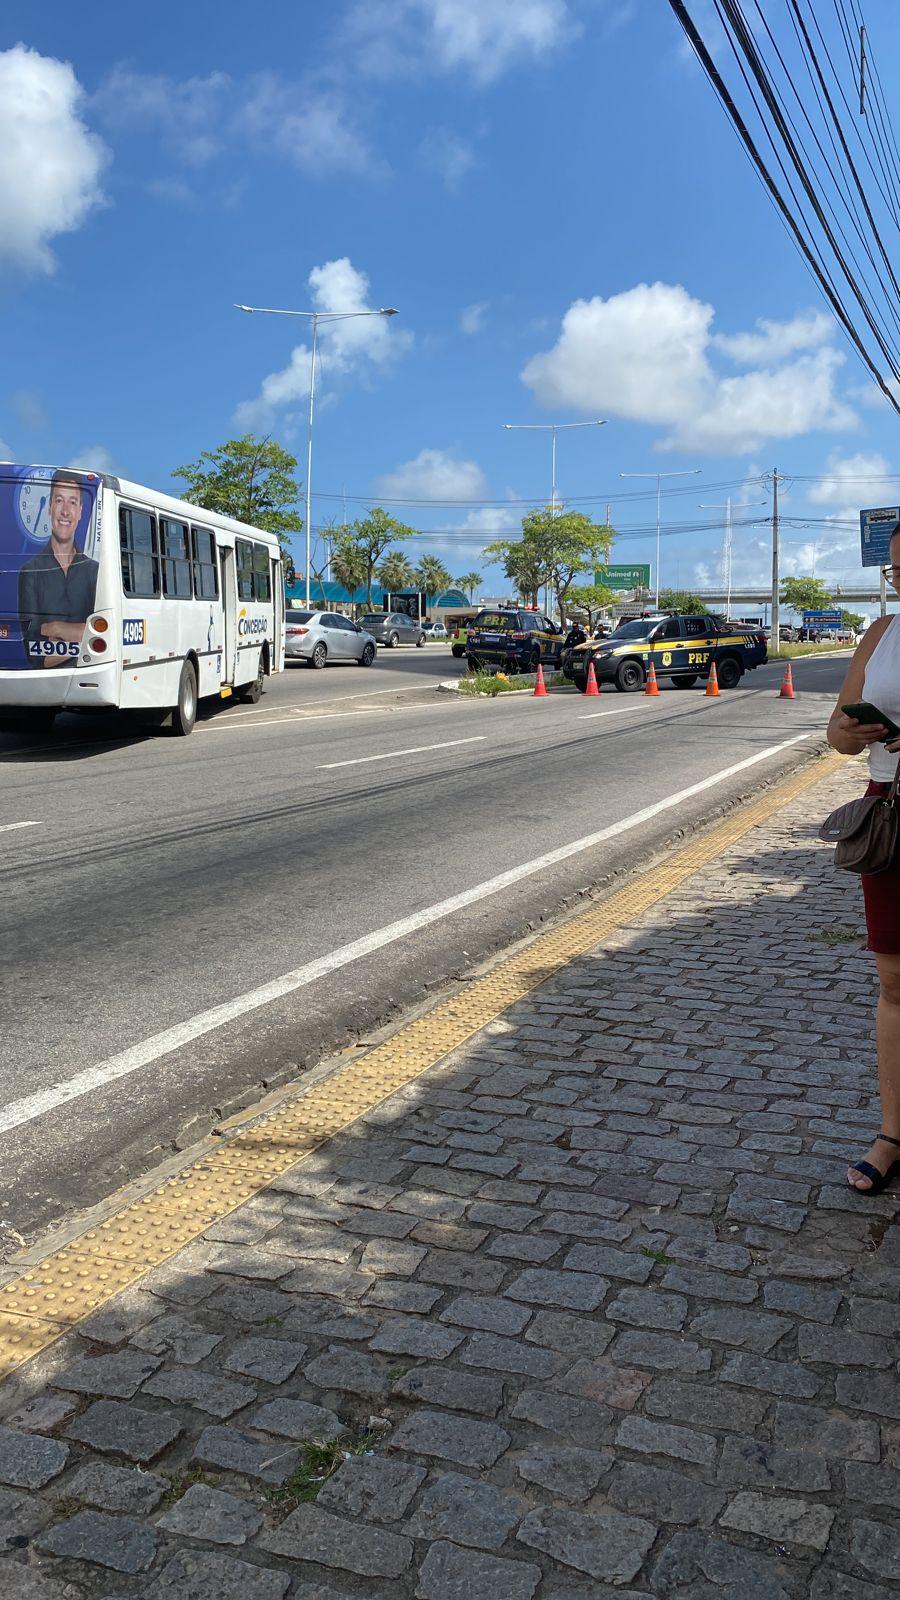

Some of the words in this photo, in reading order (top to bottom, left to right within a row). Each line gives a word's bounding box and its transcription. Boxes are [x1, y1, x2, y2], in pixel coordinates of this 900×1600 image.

[24, 486, 31, 494] 10
[22, 501, 27, 510] 9
[26, 515, 31, 524] 8
[43, 524, 48, 532] 6
[483, 616, 509, 626] PRF
[124, 621, 144, 642] 4905
[30, 641, 80, 656] 4905
[688, 652, 710, 664] PRF
